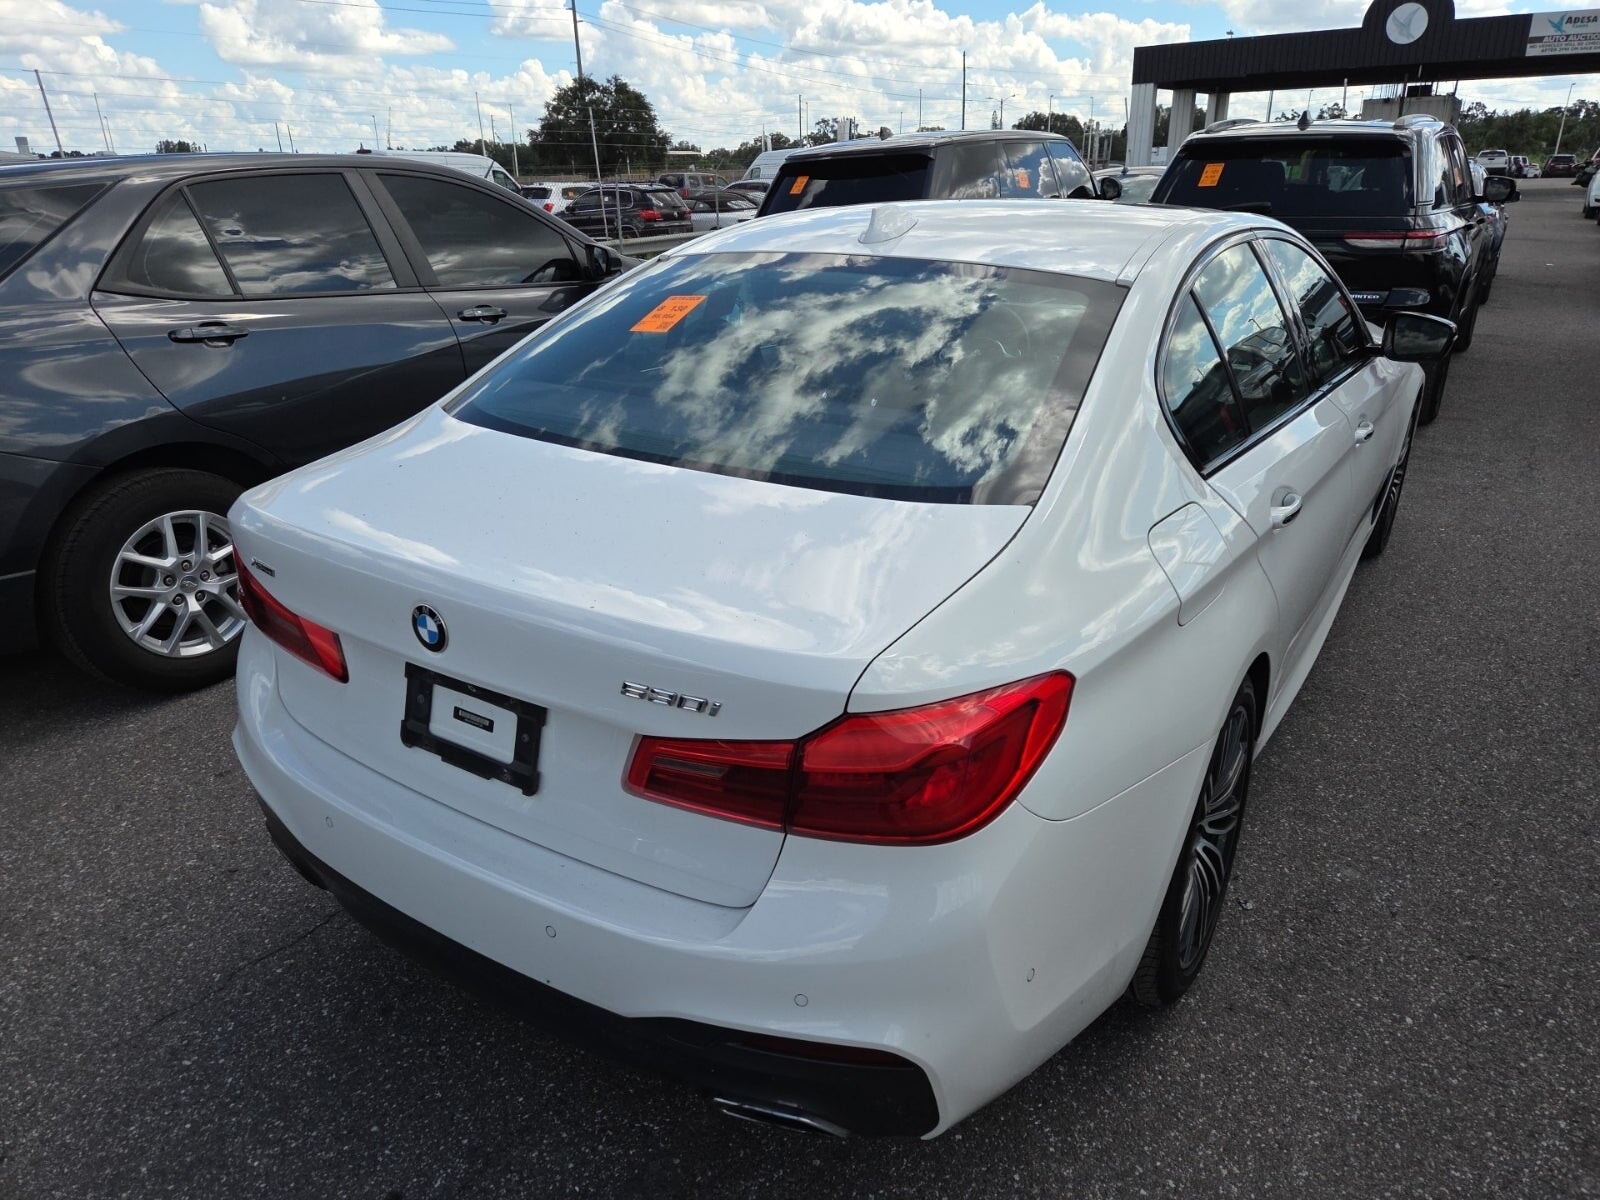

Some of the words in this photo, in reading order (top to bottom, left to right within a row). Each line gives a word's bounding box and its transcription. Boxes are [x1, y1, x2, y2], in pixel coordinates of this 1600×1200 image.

[1565, 15, 1598, 25] ADESA
[1543, 35, 1567, 43] AUTO
[620, 680, 722, 717] 530i
